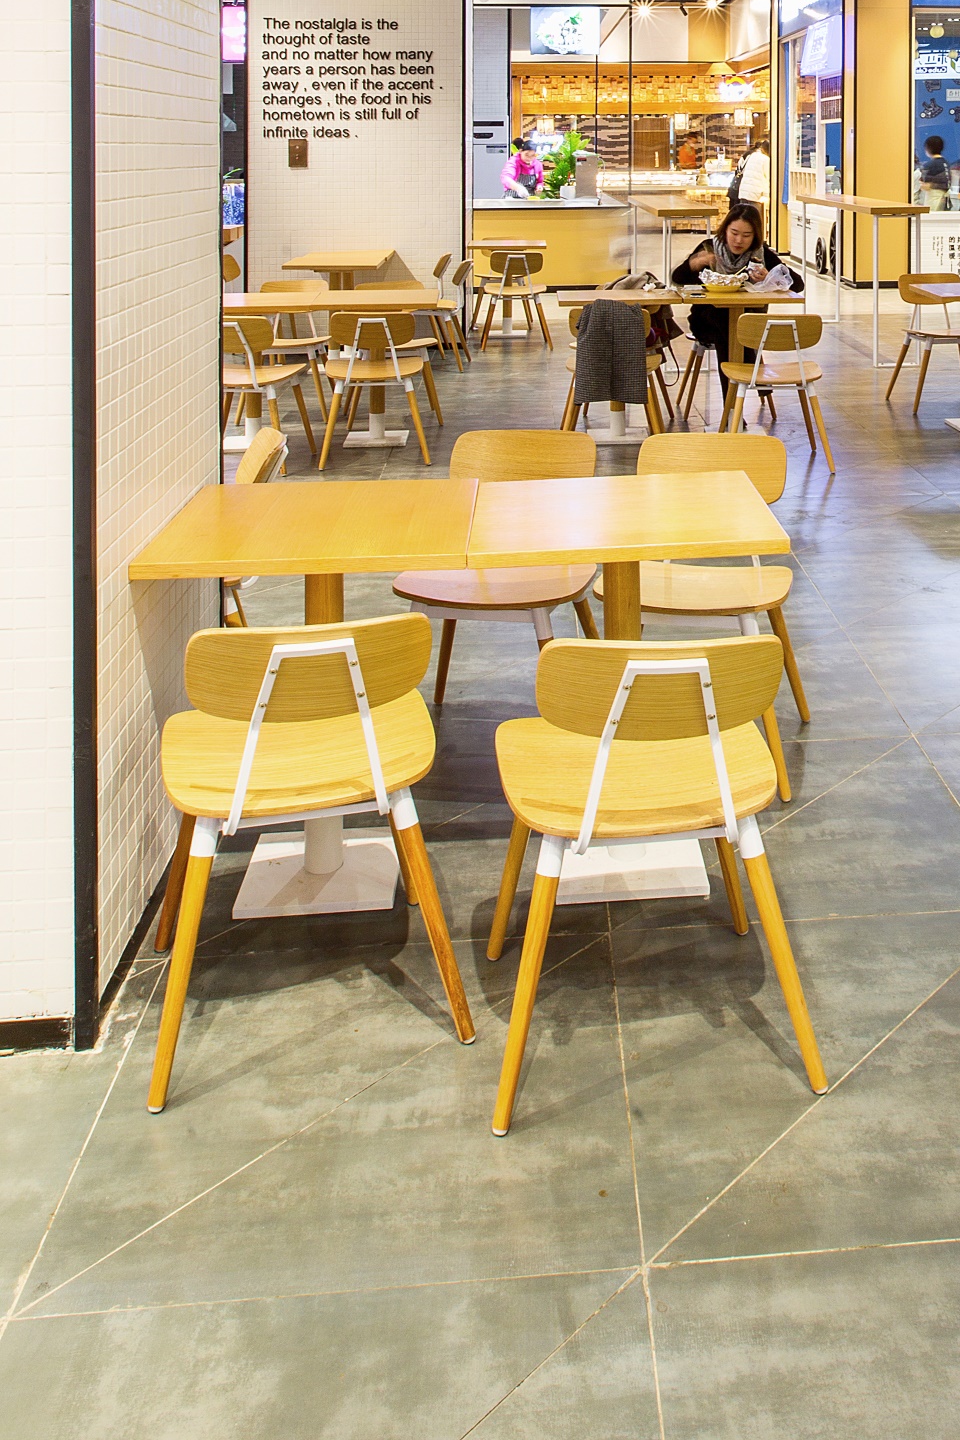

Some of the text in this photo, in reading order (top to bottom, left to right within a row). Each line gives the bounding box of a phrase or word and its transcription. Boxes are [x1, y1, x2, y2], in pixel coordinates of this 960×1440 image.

[262, 17, 291, 30] The
[361, 18, 373, 30] is
[376, 18, 399, 30] the
[262, 33, 371, 48] thought of taste
[261, 48, 434, 63] and no matter how many
[262, 63, 434, 78] years a person has been
[262, 81, 299, 94] away
[311, 81, 346, 91] even
[350, 78, 360, 91] if
[362, 78, 384, 91] the
[388, 78, 434, 91] accent
[262, 93, 322, 108] changes
[335, 93, 357, 105] the
[361, 93, 391, 105] food
[395, 93, 407, 105] in
[412, 93, 432, 105] his
[262, 108, 420, 121] hometown is still full of
[262, 126, 308, 138] infinite
[313, 126, 350, 138] ideas
